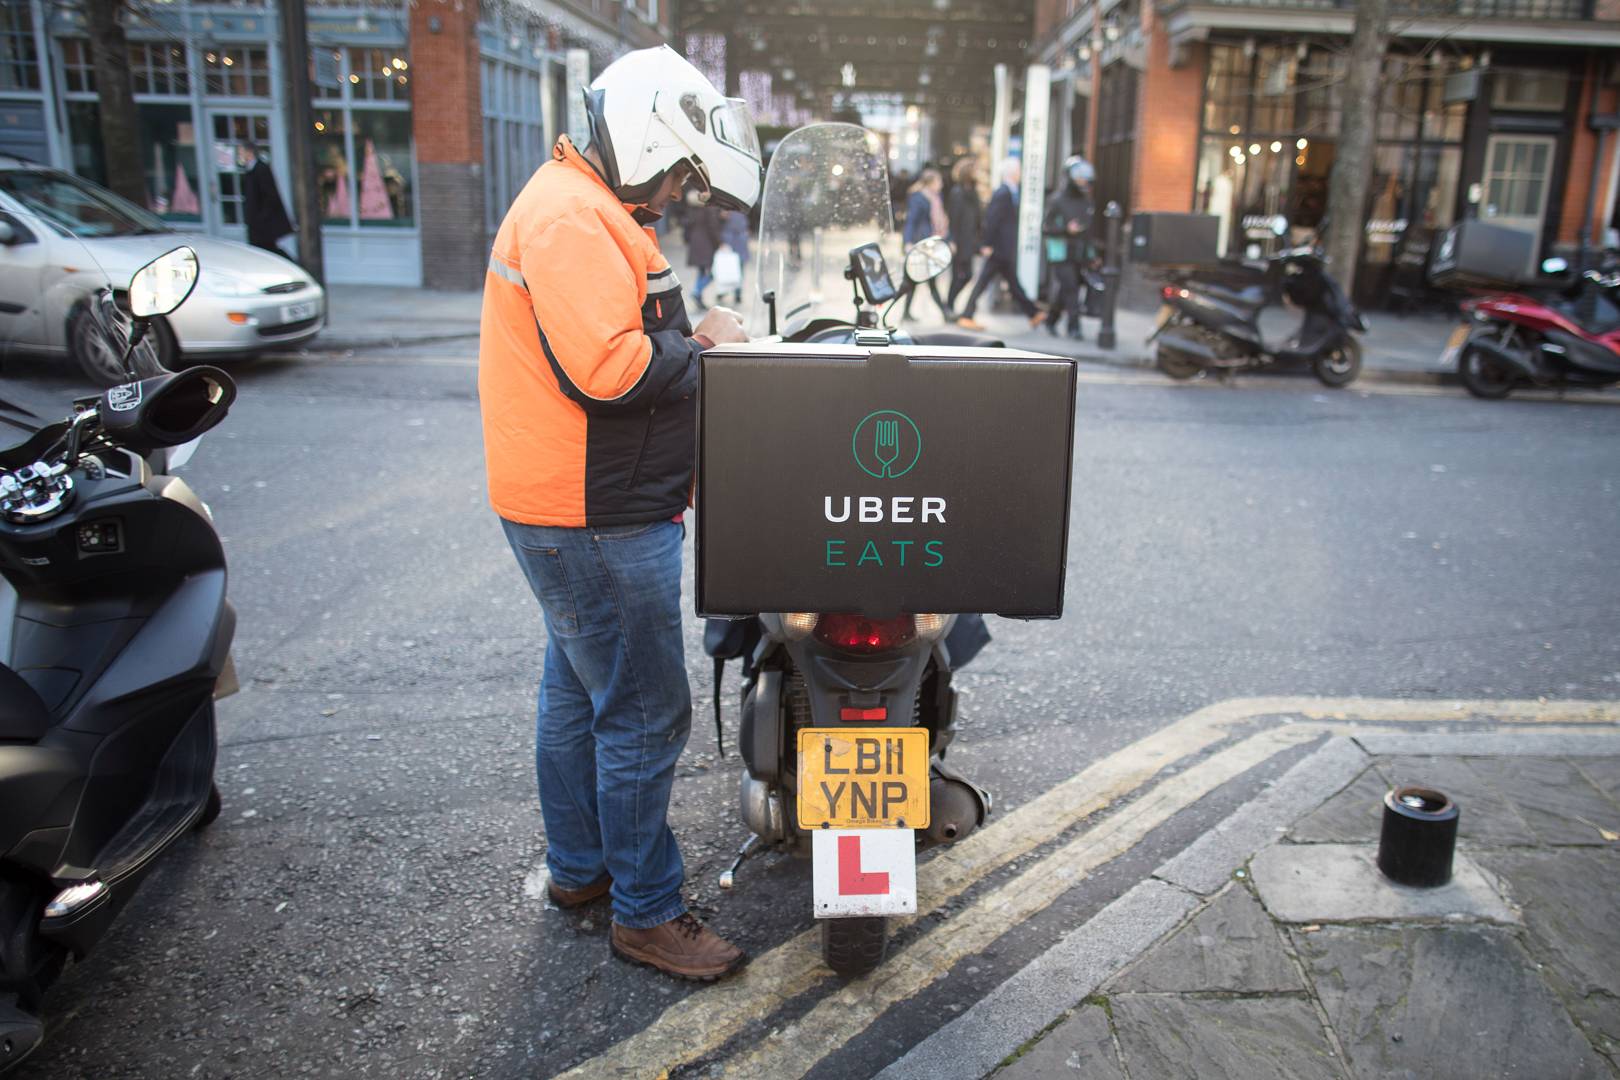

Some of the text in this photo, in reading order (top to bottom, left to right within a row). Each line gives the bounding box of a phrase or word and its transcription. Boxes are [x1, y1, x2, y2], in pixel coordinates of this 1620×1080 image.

[824, 496, 947, 524] UBER
[826, 540, 944, 567] EATS
[820, 781, 908, 819] YNP
[837, 835, 890, 896] L
